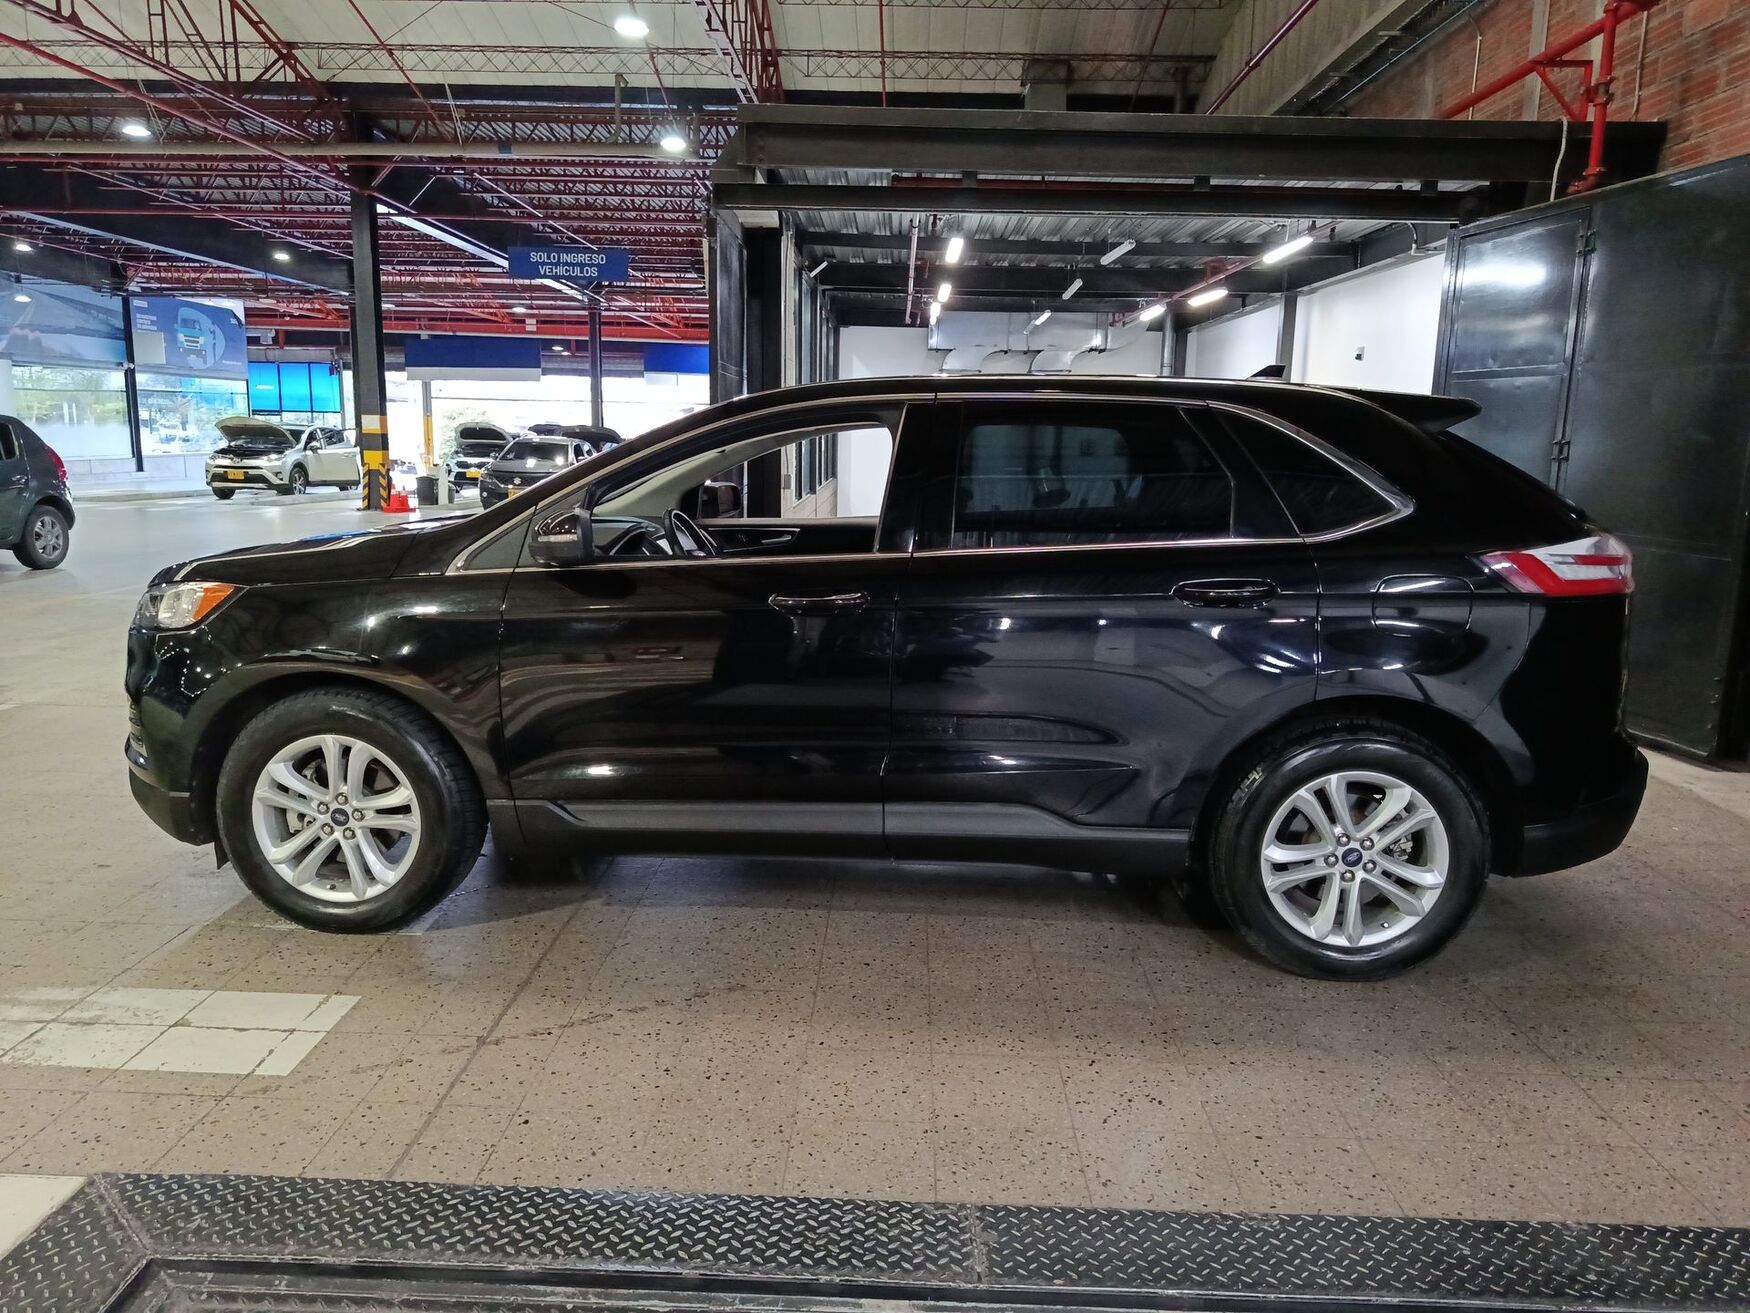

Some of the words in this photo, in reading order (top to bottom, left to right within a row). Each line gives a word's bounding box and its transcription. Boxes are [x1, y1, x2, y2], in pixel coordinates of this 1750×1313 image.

[530, 252, 558, 262] SOLO
[560, 253, 606, 264] INGRESO
[538, 264, 598, 277] VEHÍCULOS
